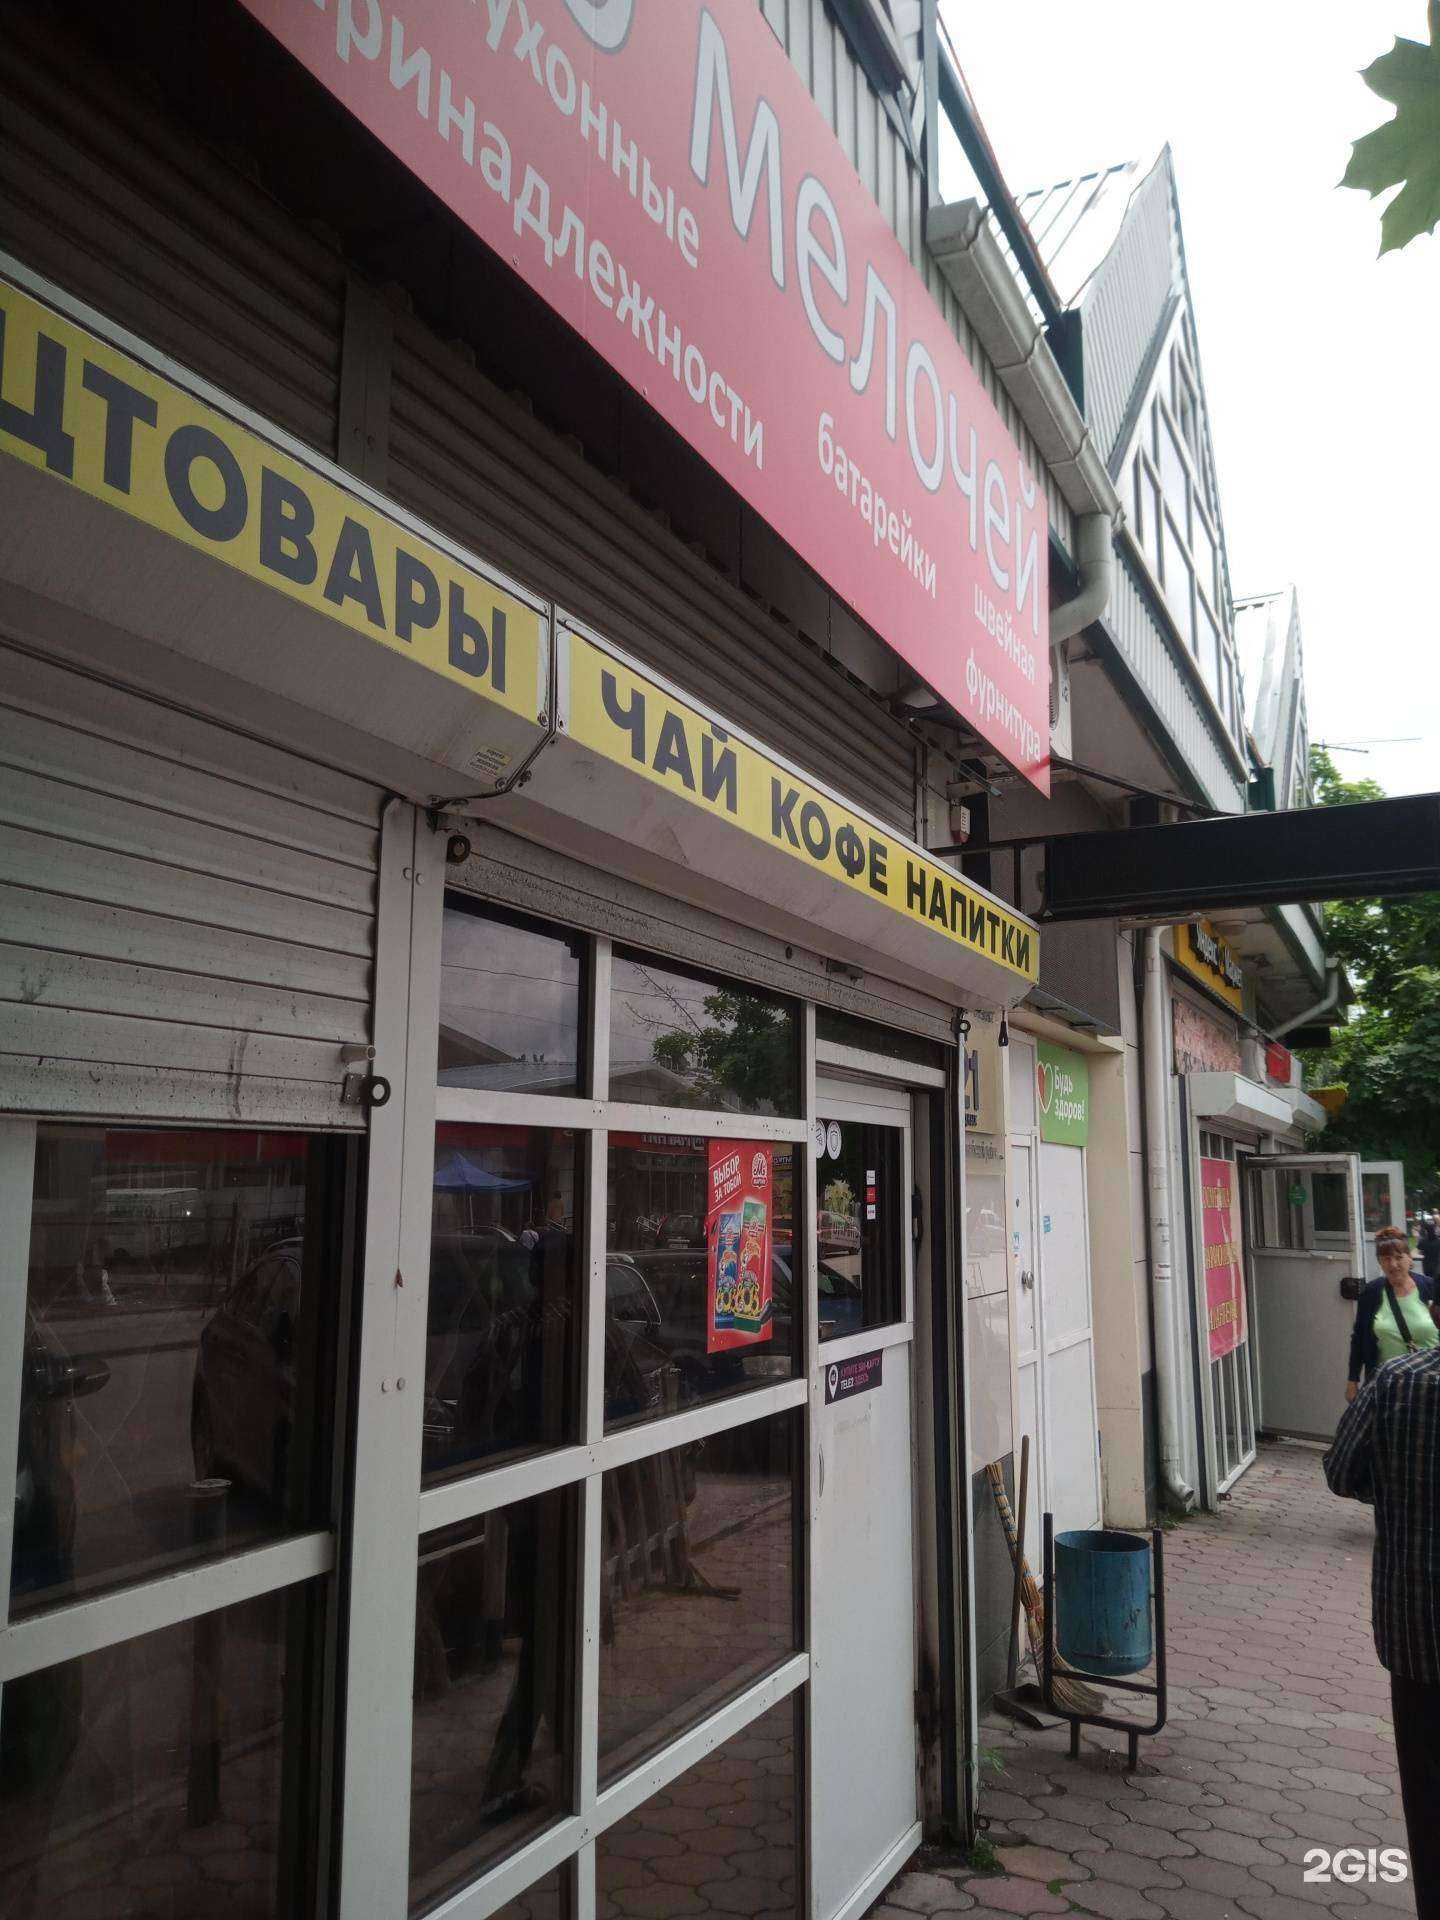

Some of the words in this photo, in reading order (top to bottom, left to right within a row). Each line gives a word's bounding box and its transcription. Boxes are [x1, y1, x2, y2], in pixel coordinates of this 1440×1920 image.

[470, 0, 699, 268] ухонные
[313, 0, 763, 471] ринадлежности
[689, 8, 1040, 636] Мелочей
[817, 411, 937, 600] батарейки
[974, 584, 1036, 685] швейная
[965, 647, 1041, 762] фурнитура
[601, 668, 738, 815] ЧАЙ
[771, 776, 889, 897] КОФЕ
[906, 859, 1031, 973] НАПИТКИ
[1054, 1065, 1073, 1098] Будь
[1054, 1099, 1085, 1126] здоров!
[713, 1155, 740, 1187] ВЫБОР
[714, 1187, 723, 1203] ЗА
[724, 1171, 742, 1196] ТОБОЙ
